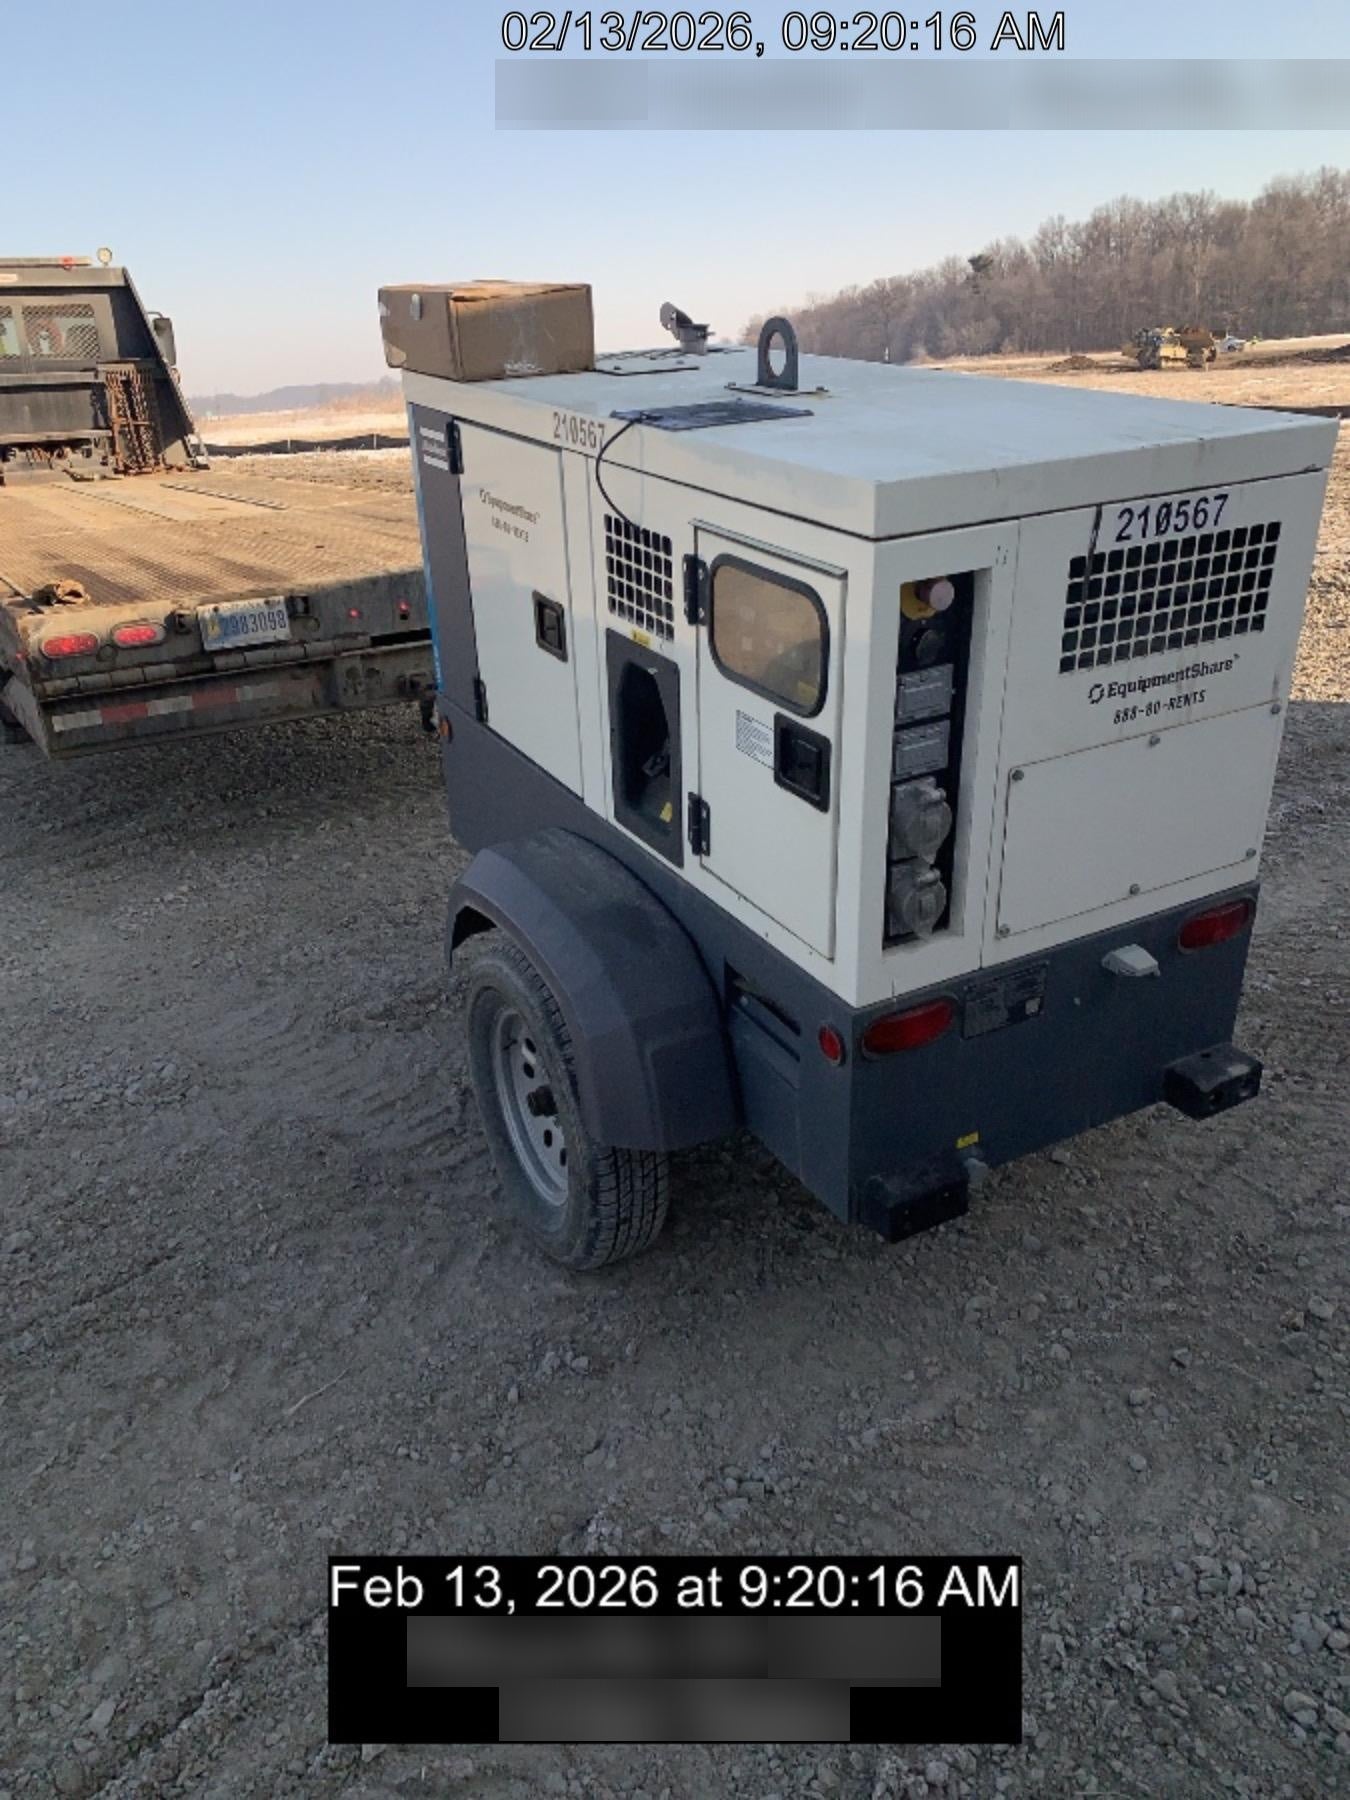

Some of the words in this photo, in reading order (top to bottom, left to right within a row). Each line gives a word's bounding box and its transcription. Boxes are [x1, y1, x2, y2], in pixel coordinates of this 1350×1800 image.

[552, 410, 607, 449] 210567
[1115, 493, 1229, 543] 210567
[1106, 658, 1234, 699] EquipmentShare
[1113, 689, 1207, 725] 888-80-RENTS
